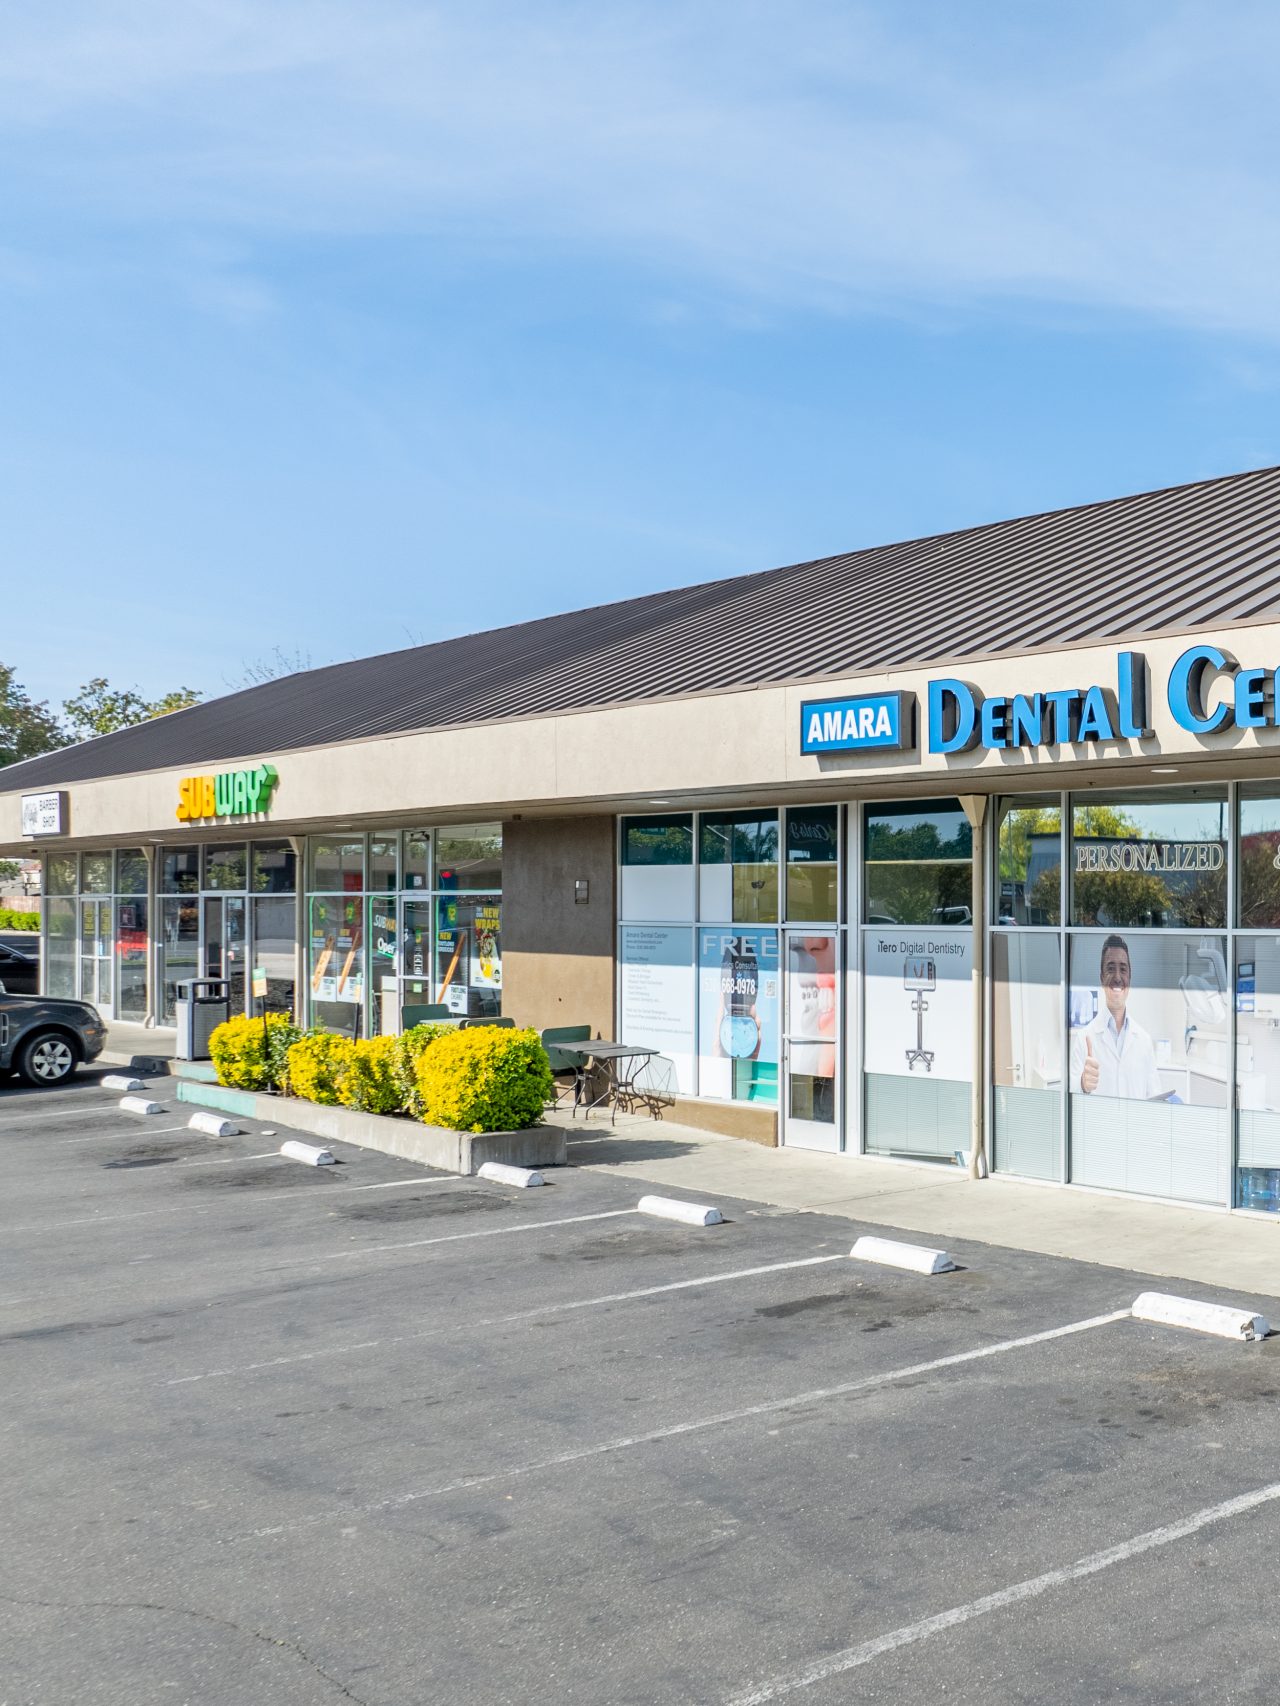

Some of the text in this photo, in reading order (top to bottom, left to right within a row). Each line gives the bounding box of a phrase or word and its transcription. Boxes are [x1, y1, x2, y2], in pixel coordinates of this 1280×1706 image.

[928, 651, 1146, 755] DENTAL
[807, 705, 892, 743] AMARA
[176, 764, 274, 819] SUBWAY
[40, 798, 58, 811] BARBER
[43, 815, 55, 828] SHOP
[1076, 844, 1224, 872] PERSONALIZED
[483, 907, 499, 918] NEW
[374, 914, 397, 932] SUBWA
[704, 935, 777, 958] FREE
[900, 942, 926, 956] Digital
[928, 942, 966, 958] Dentistry
[722, 978, 756, 995] 668-0978
